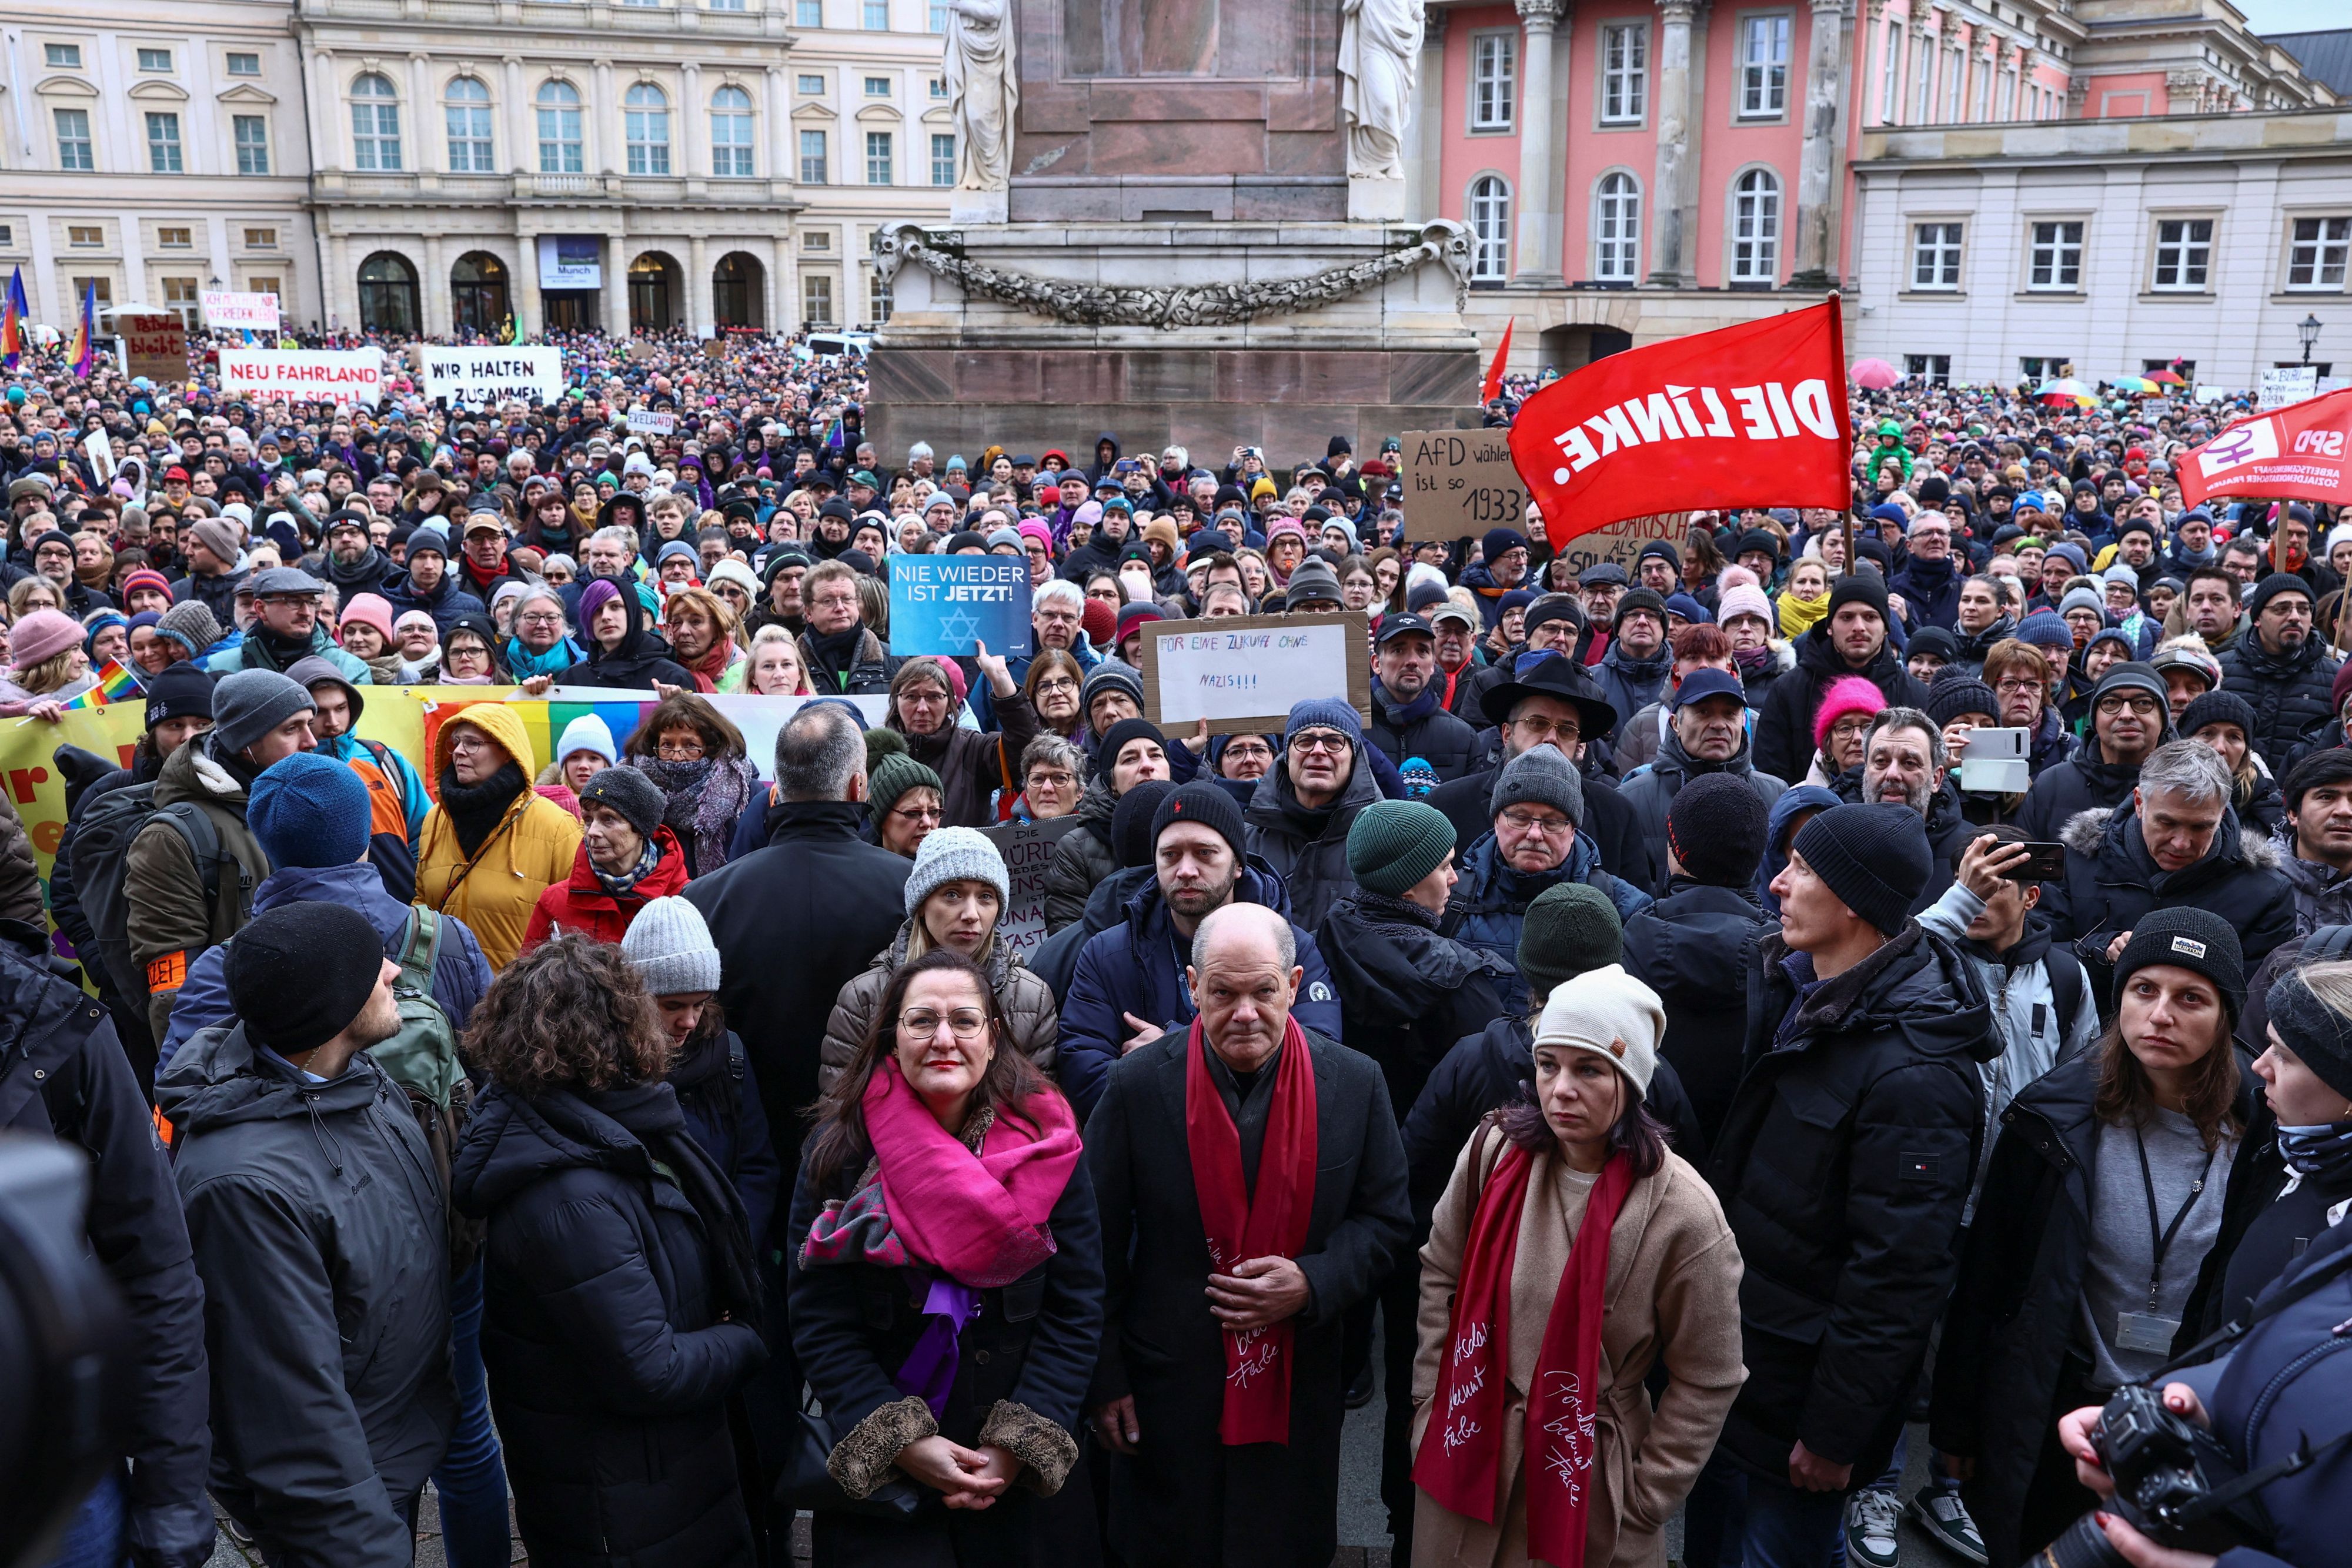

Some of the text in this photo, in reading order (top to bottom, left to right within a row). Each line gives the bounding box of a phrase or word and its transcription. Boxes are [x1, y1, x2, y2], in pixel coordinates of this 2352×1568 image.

[558, 266, 591, 274] Munch
[131, 335, 181, 355] bleibt
[230, 364, 377, 383] NEU FAHRLAND
[432, 361, 534, 379] WIR HALTEN
[455, 386, 543, 403] ZUSAMMEN
[1415, 437, 1465, 466] AfD
[1416, 472, 1465, 491] ist so
[1462, 488, 1521, 521] 1933
[1609, 540, 1638, 556] ALS
[896, 566, 1025, 583] NIE WIEDER
[908, 586, 1013, 602] IST JETZT!
[1191, 636, 1218, 651] EINE
[1278, 636, 1308, 648] OHNE
[1015, 829, 1039, 840] DIE
[2174, 944, 2202, 956] BURTON
